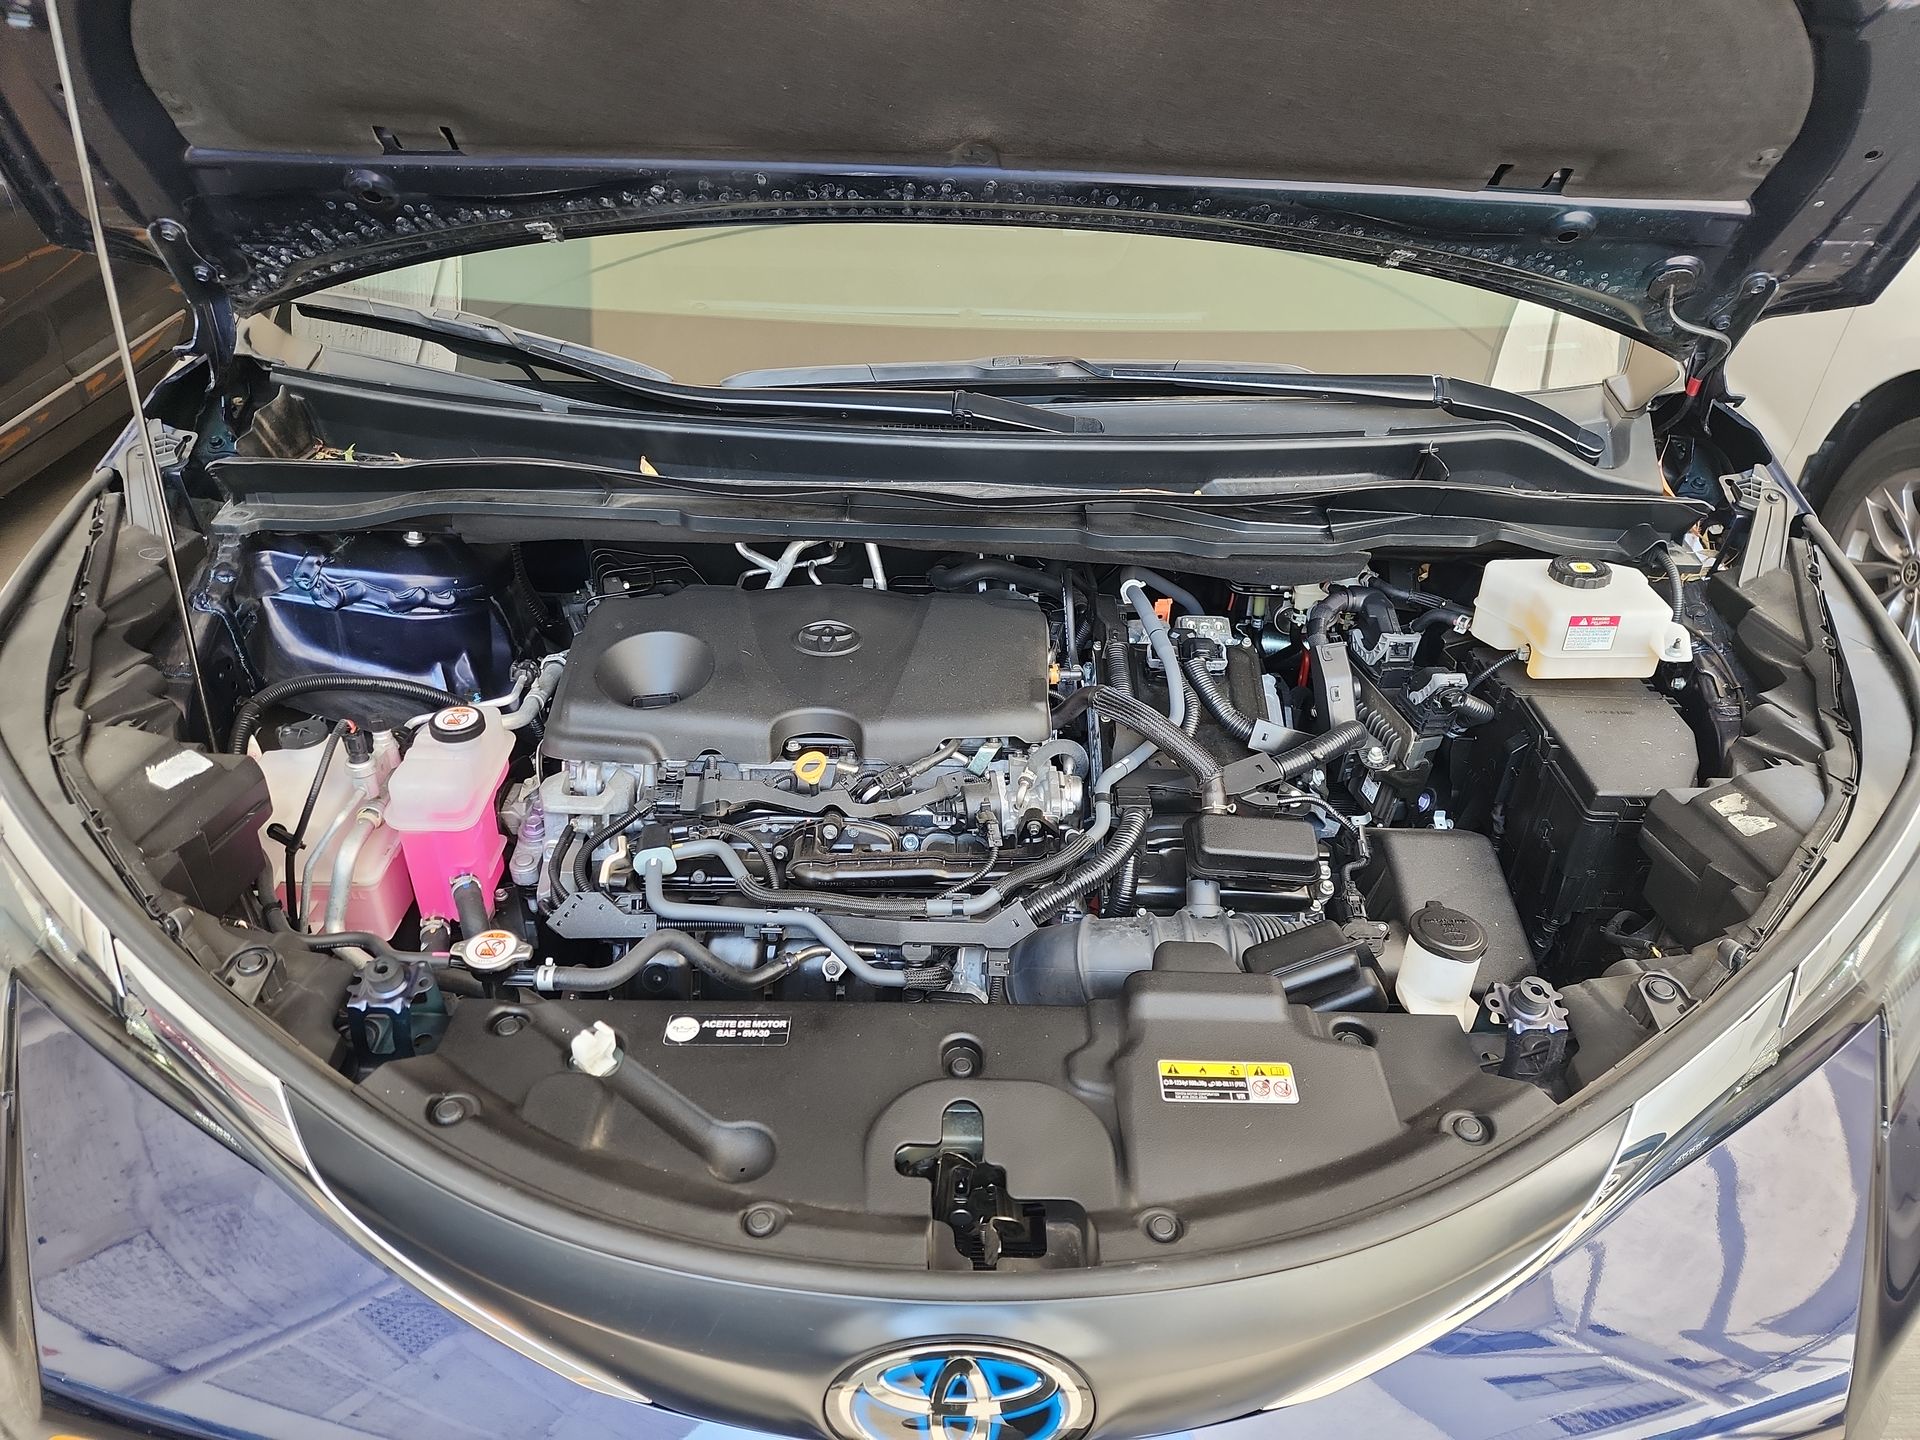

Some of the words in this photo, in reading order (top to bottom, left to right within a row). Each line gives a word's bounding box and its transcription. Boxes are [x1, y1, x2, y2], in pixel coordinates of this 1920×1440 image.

[702, 1020, 737, 1028] ACEITE
[737, 1020, 752, 1028] DE
[752, 1020, 787, 1028] MOTOR
[716, 1029, 737, 1038] SAE
[742, 1029, 771, 1038] 5W-30
